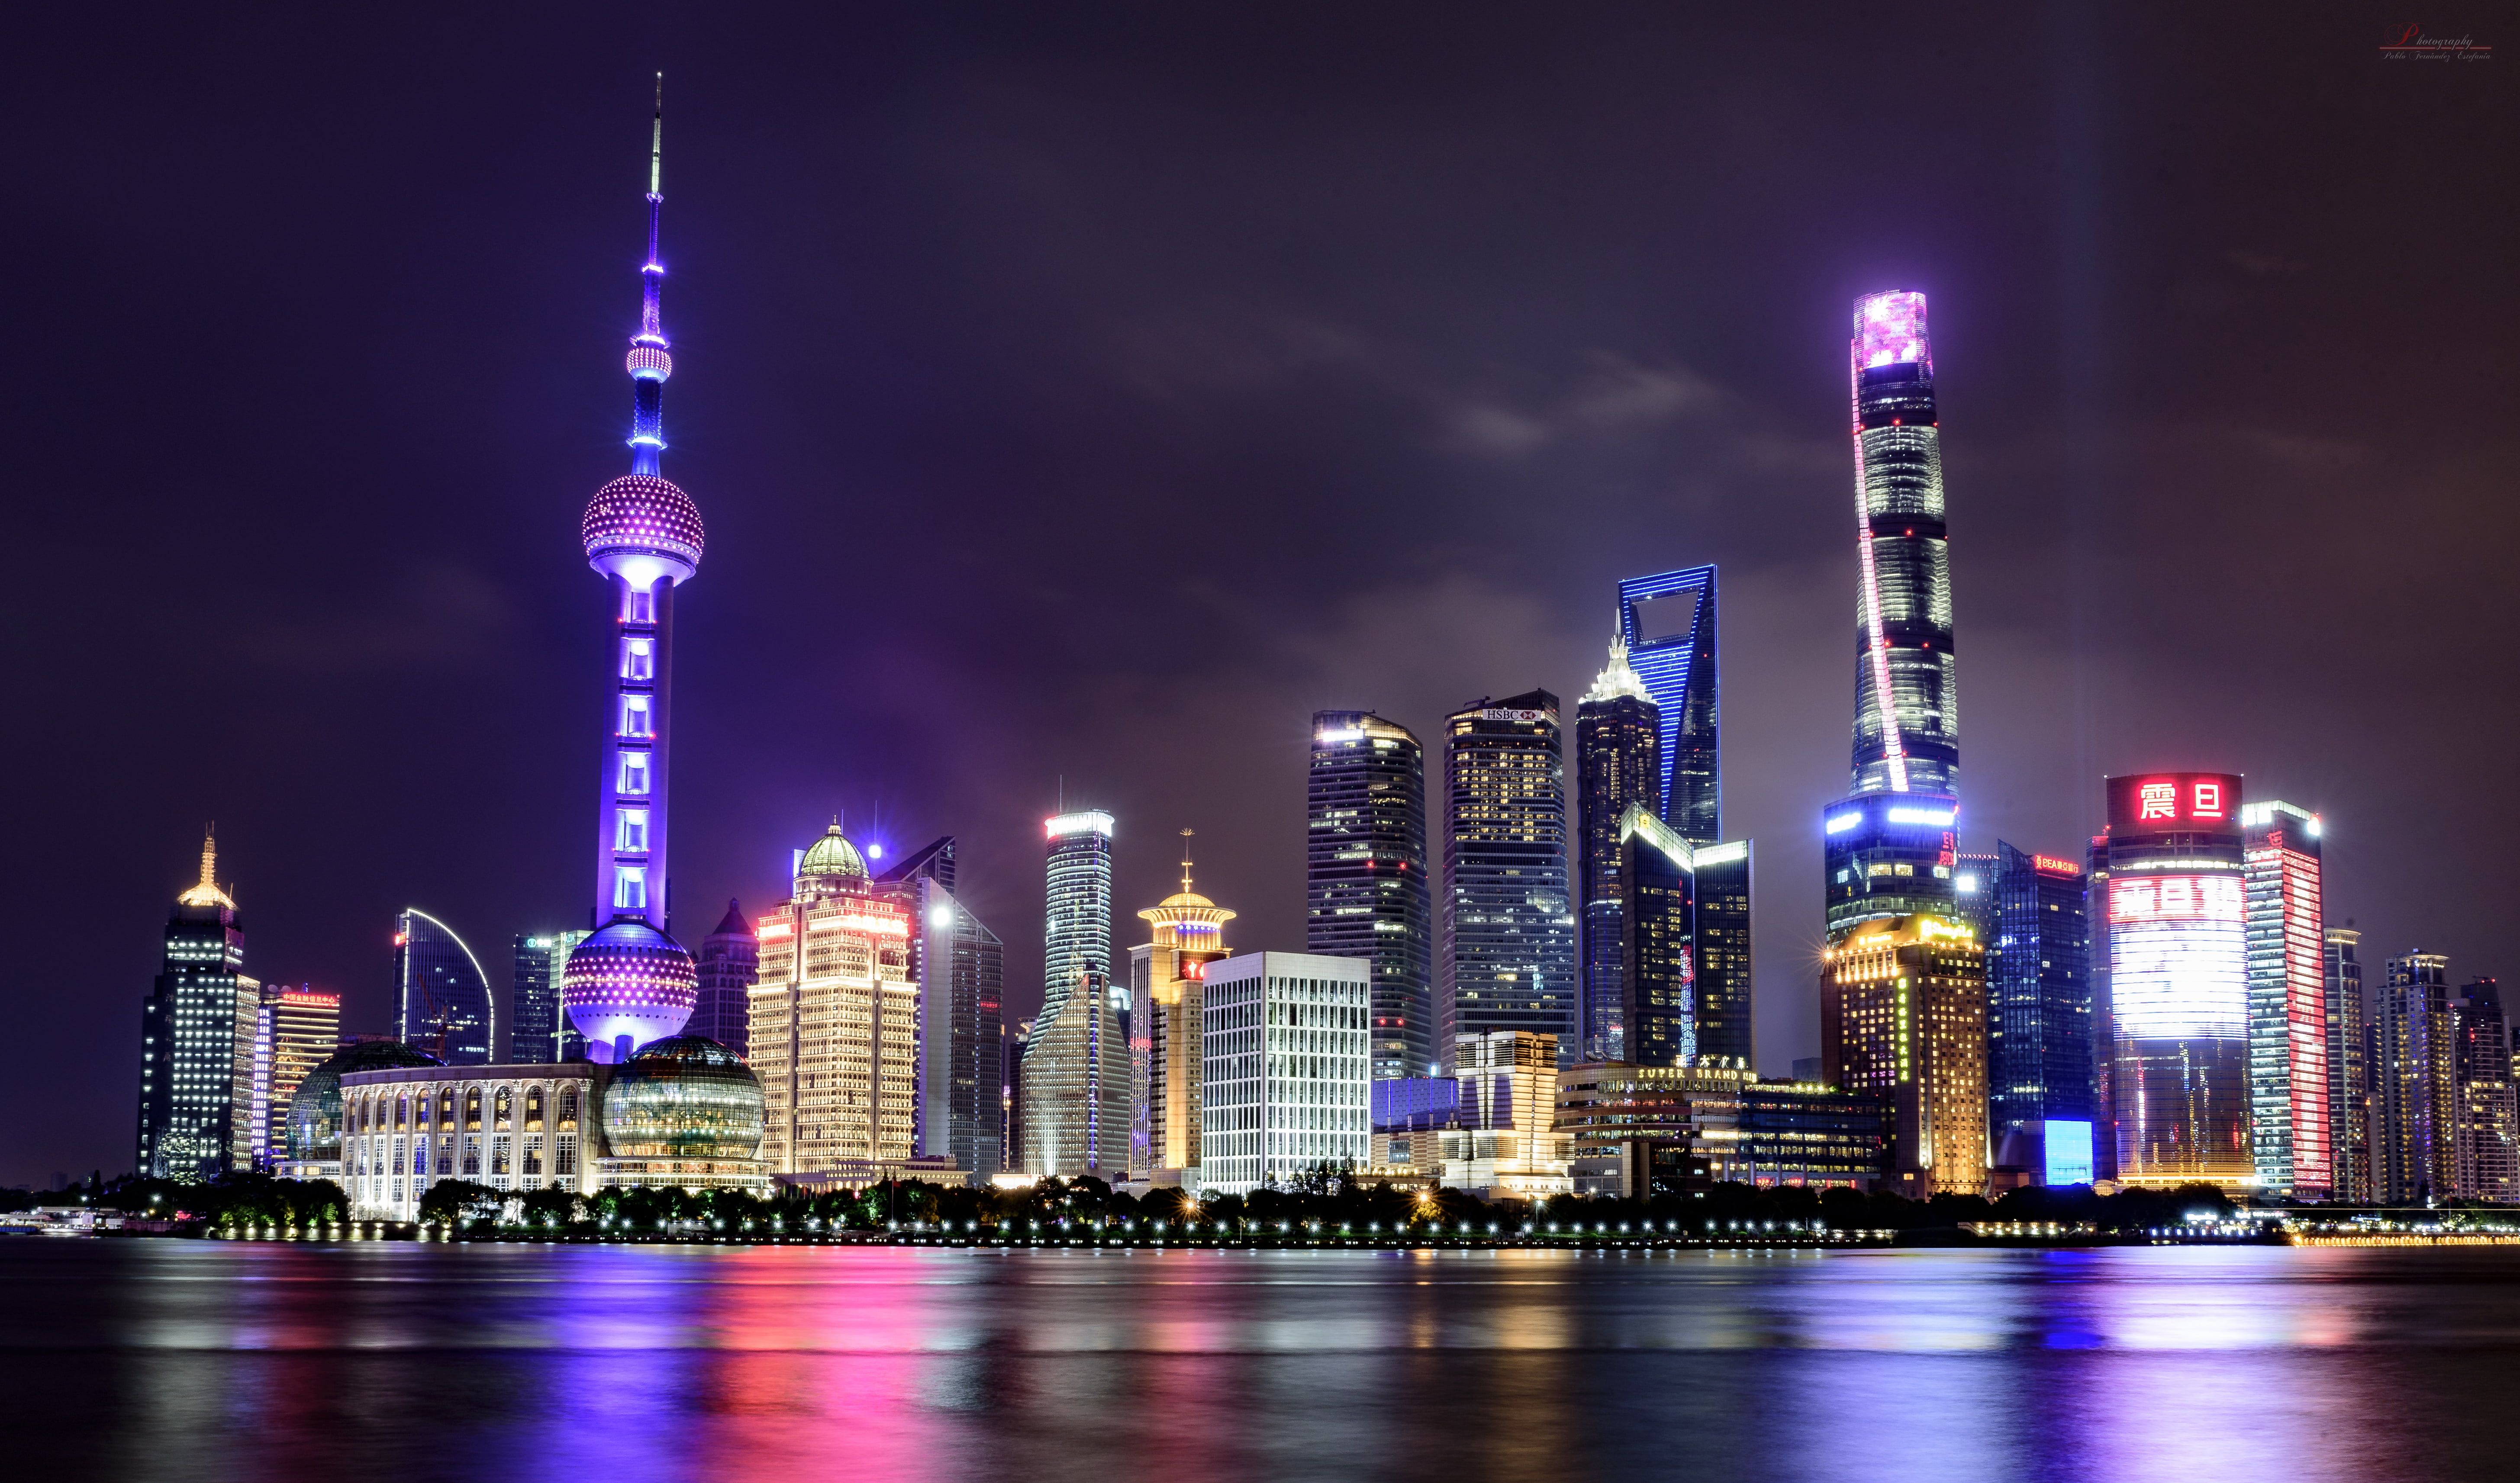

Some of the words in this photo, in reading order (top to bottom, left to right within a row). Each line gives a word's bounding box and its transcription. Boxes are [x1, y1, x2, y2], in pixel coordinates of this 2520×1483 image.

[1487, 710, 1519, 720] HSBC
[2140, 783, 2222, 819] 震旦
[2043, 858, 2057, 869] BEA
[1639, 1068, 1685, 1078] SUPER
[1697, 1069, 1737, 1080] BRAND
